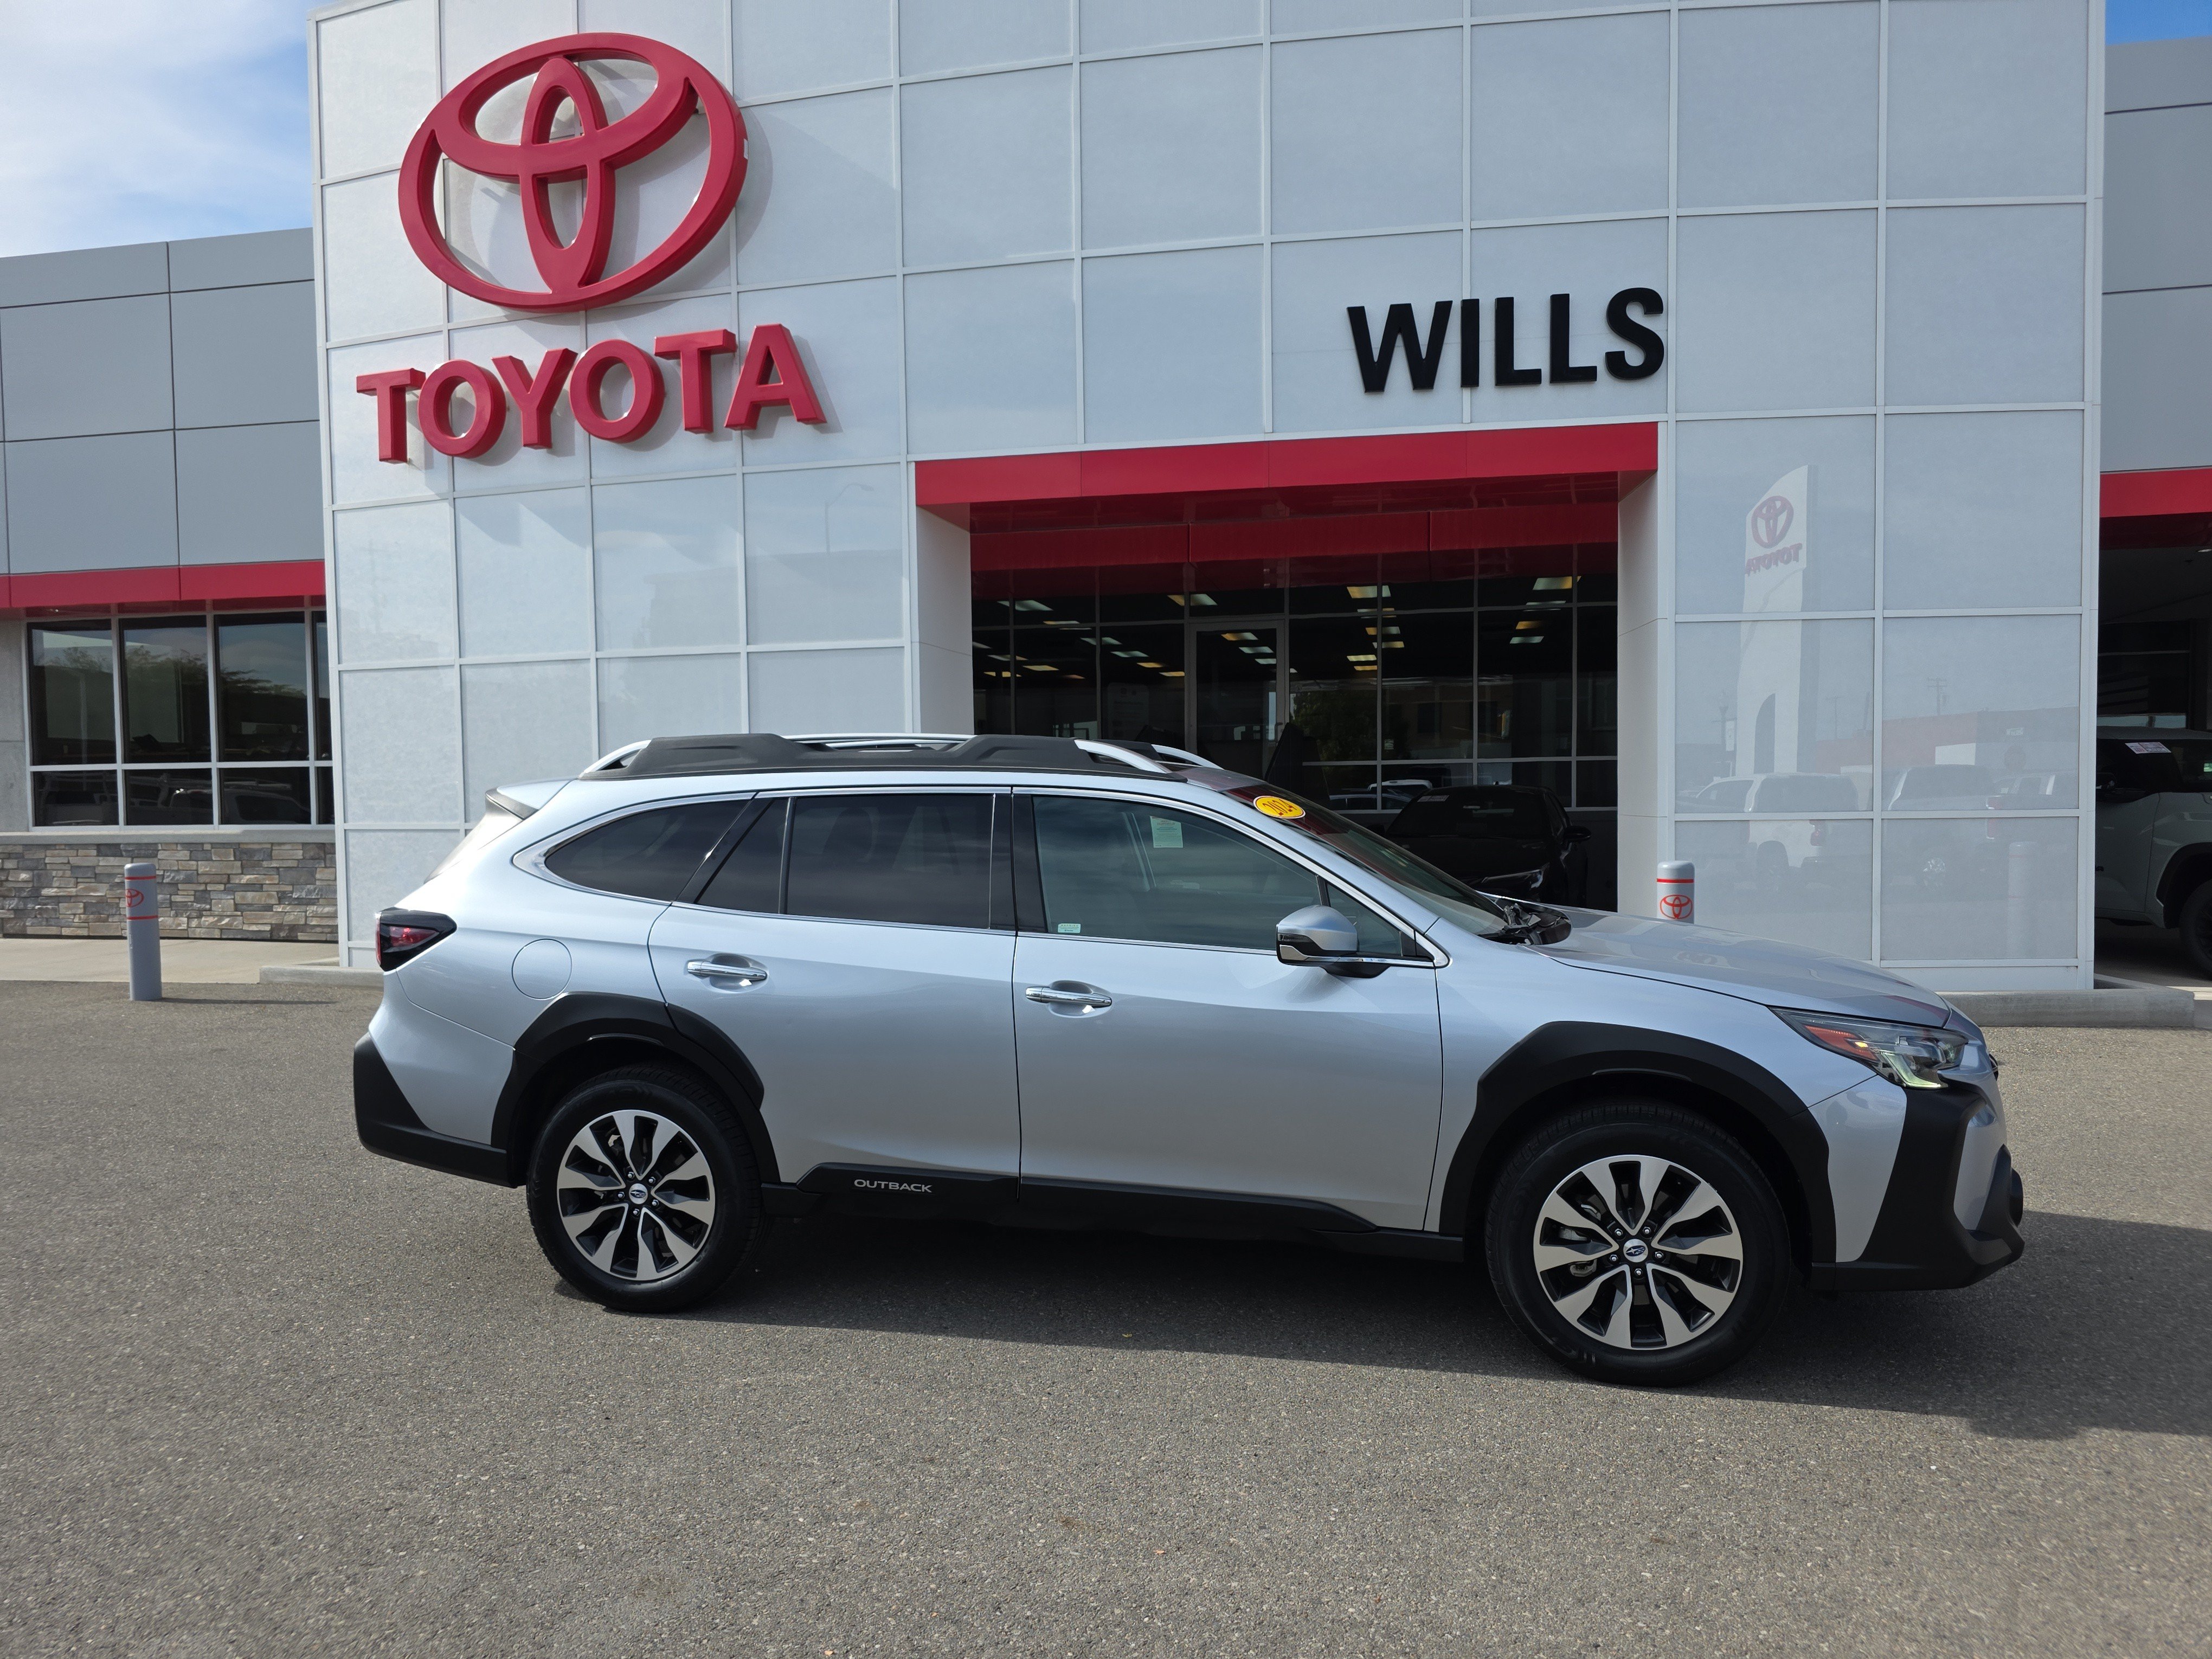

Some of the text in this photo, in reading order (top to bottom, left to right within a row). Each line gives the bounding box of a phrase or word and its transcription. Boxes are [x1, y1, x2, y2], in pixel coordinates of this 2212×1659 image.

[1347, 287, 1664, 393] WILLS
[356, 324, 827, 464] TOYOTA
[1262, 799, 1297, 816] 2024
[854, 1179, 932, 1193] OUTBACK
